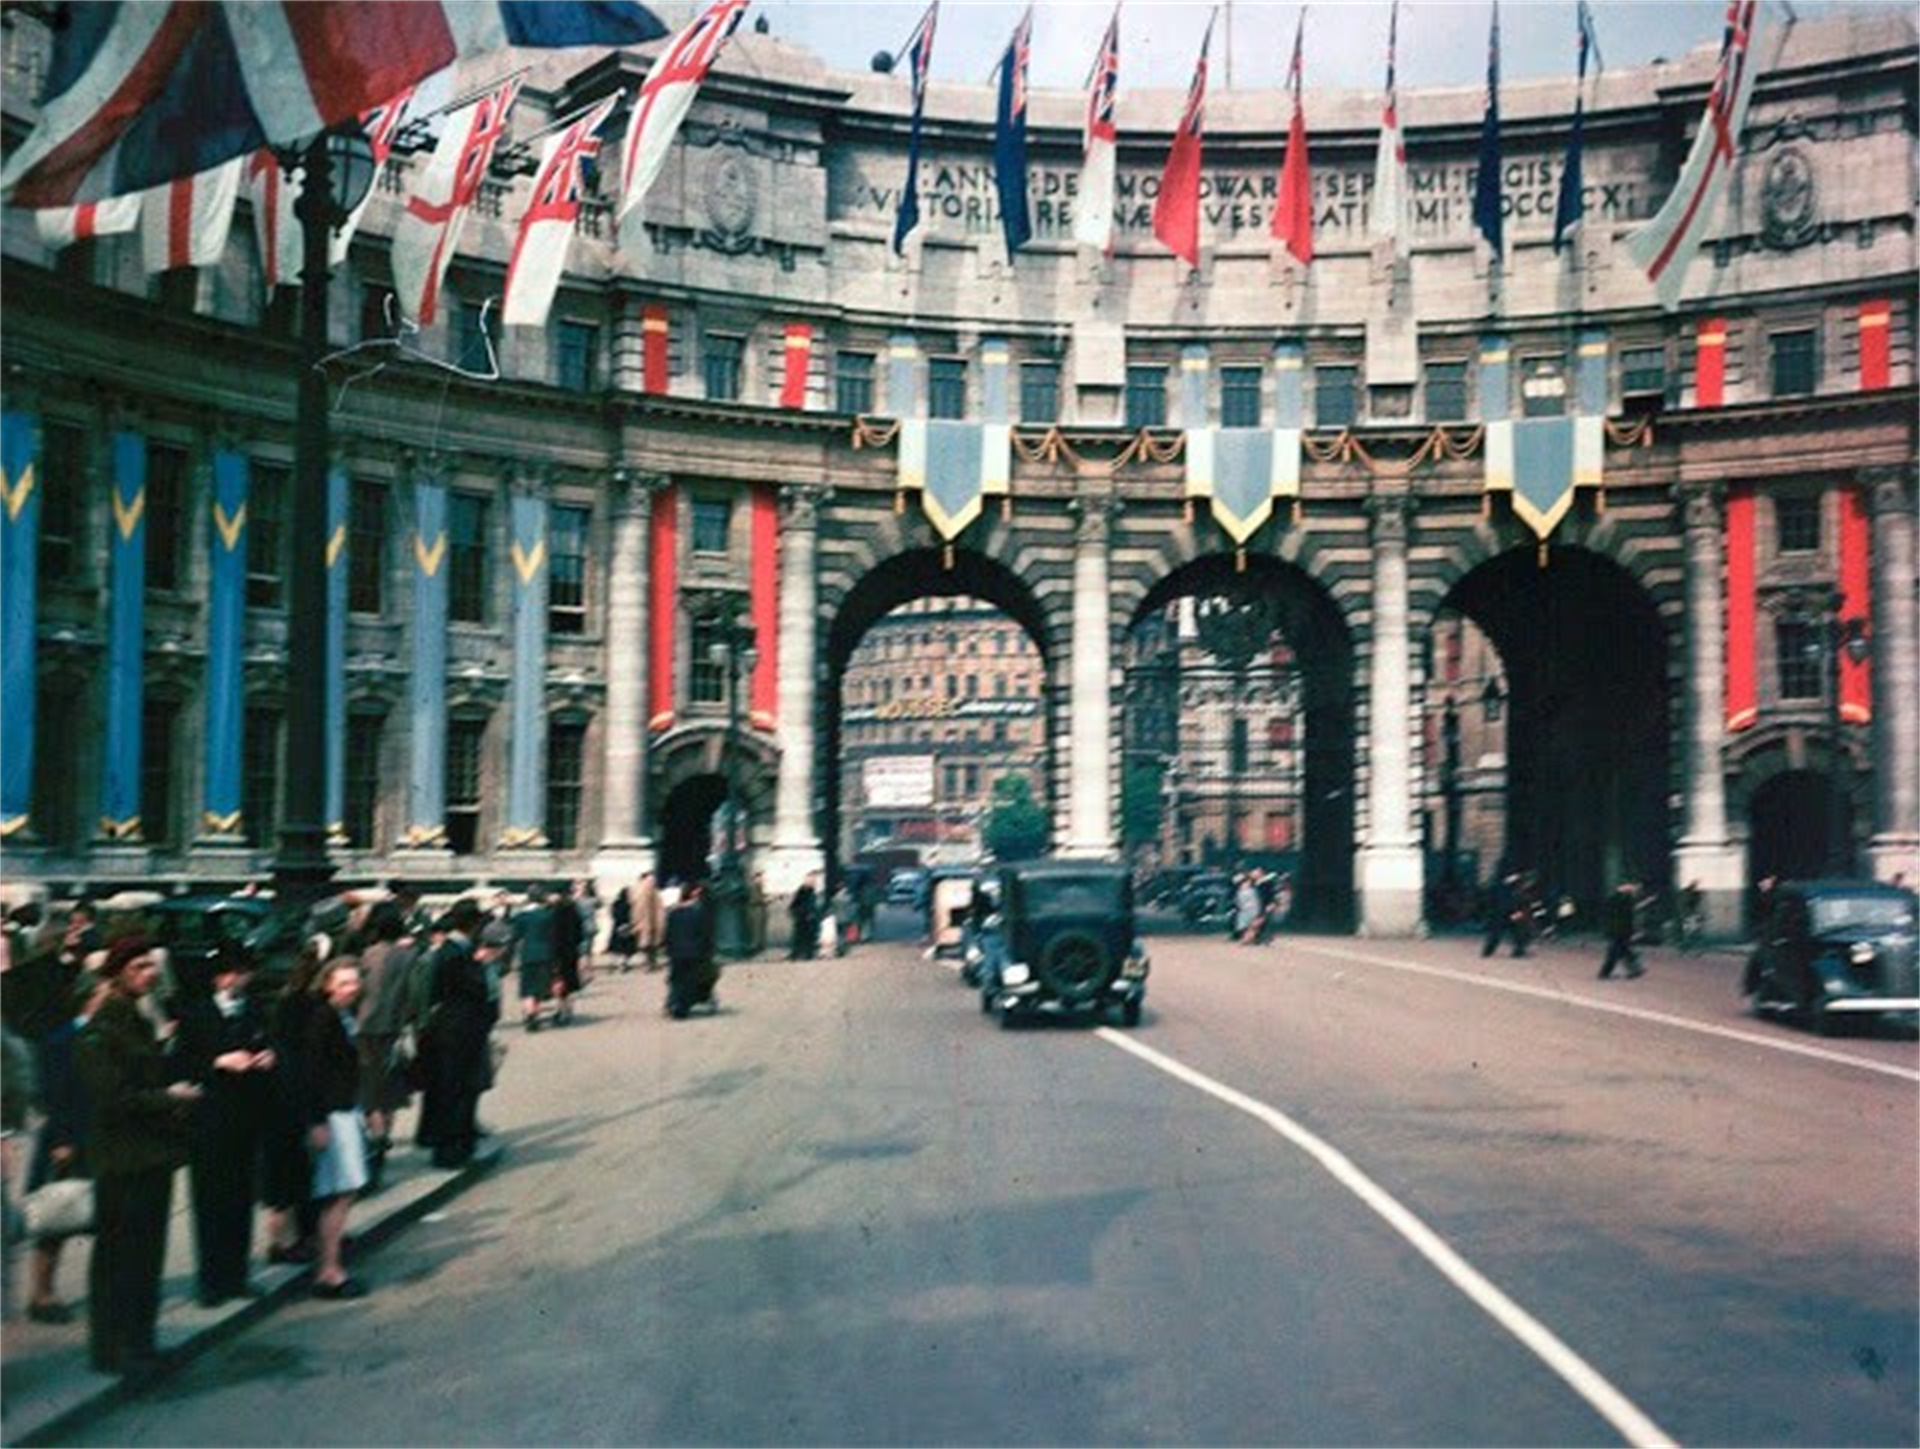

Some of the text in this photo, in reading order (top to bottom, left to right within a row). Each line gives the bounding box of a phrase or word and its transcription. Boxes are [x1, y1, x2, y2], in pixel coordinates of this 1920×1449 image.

[1044, 171, 1161, 198] DEMO
[1036, 200, 1151, 227] RENÆ
[1204, 204, 1262, 228] VES
